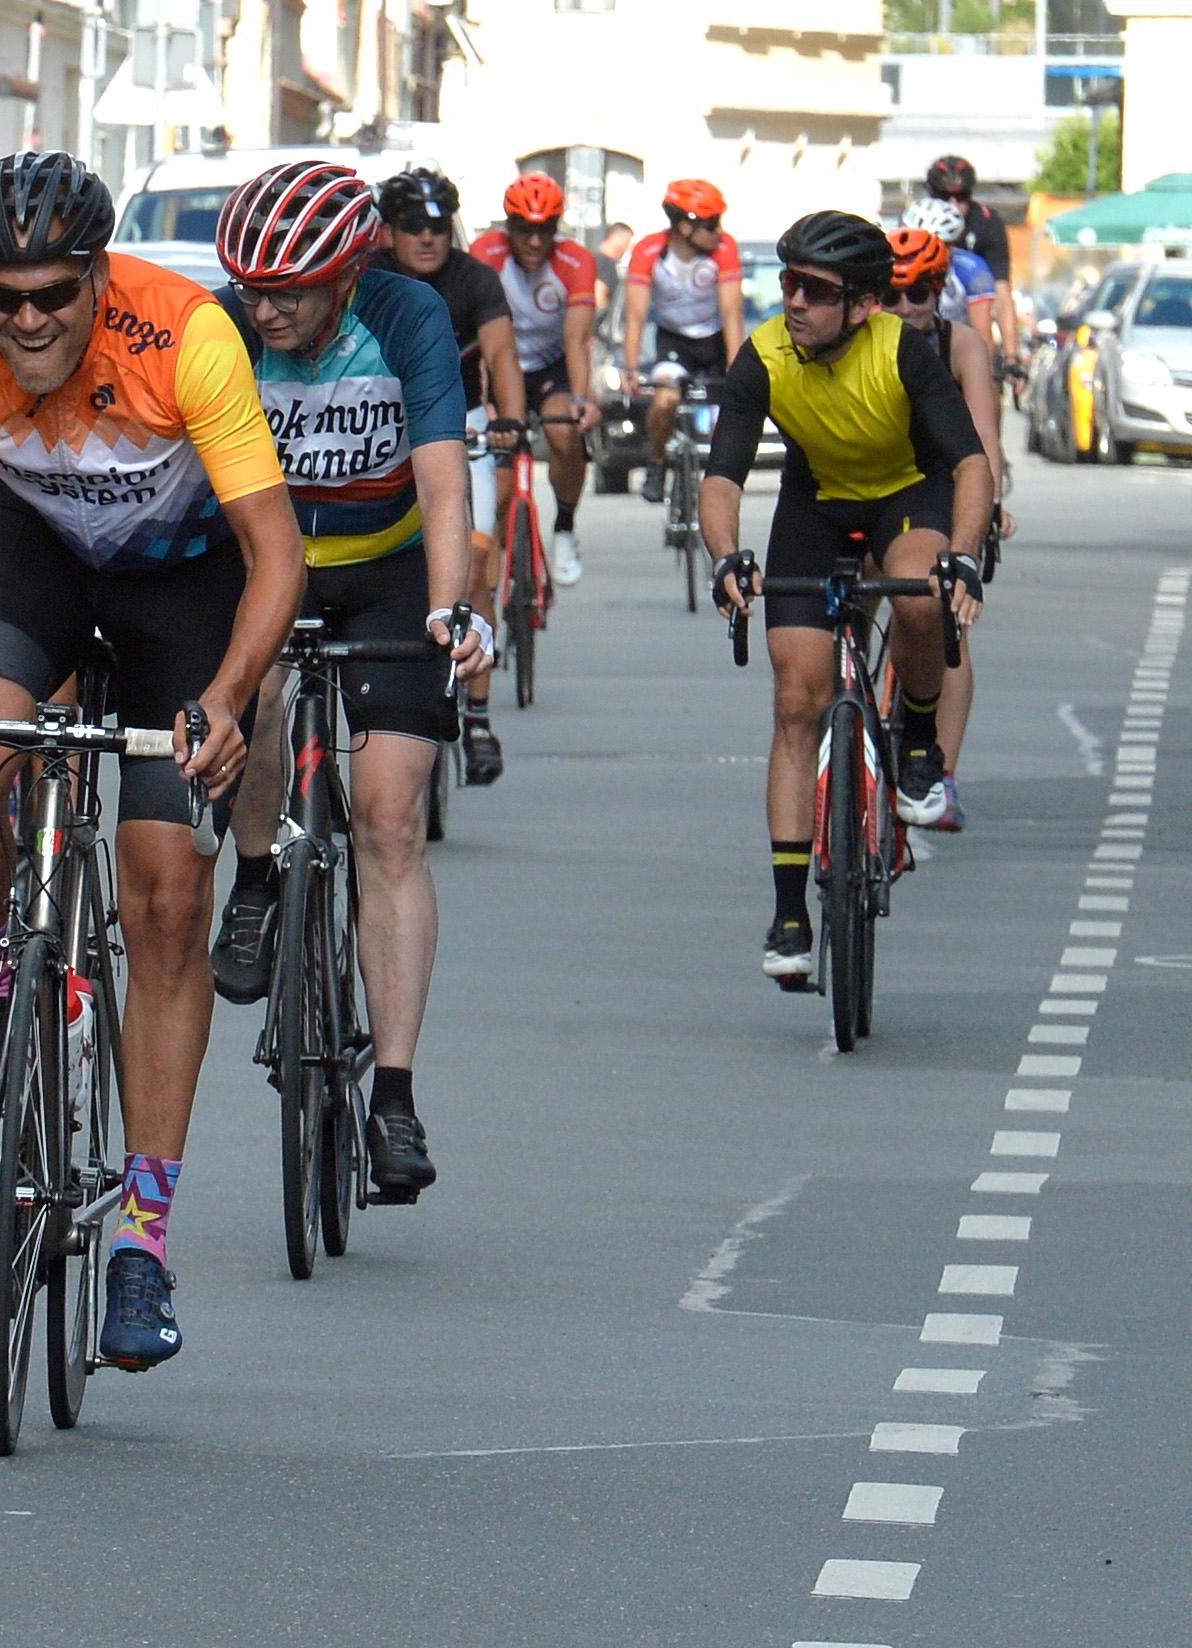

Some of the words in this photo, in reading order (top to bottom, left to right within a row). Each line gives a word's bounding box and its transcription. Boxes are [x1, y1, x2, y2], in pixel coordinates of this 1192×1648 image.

[105, 307, 175, 355] enzo
[264, 399, 310, 439] ok
[314, 400, 404, 435] mum
